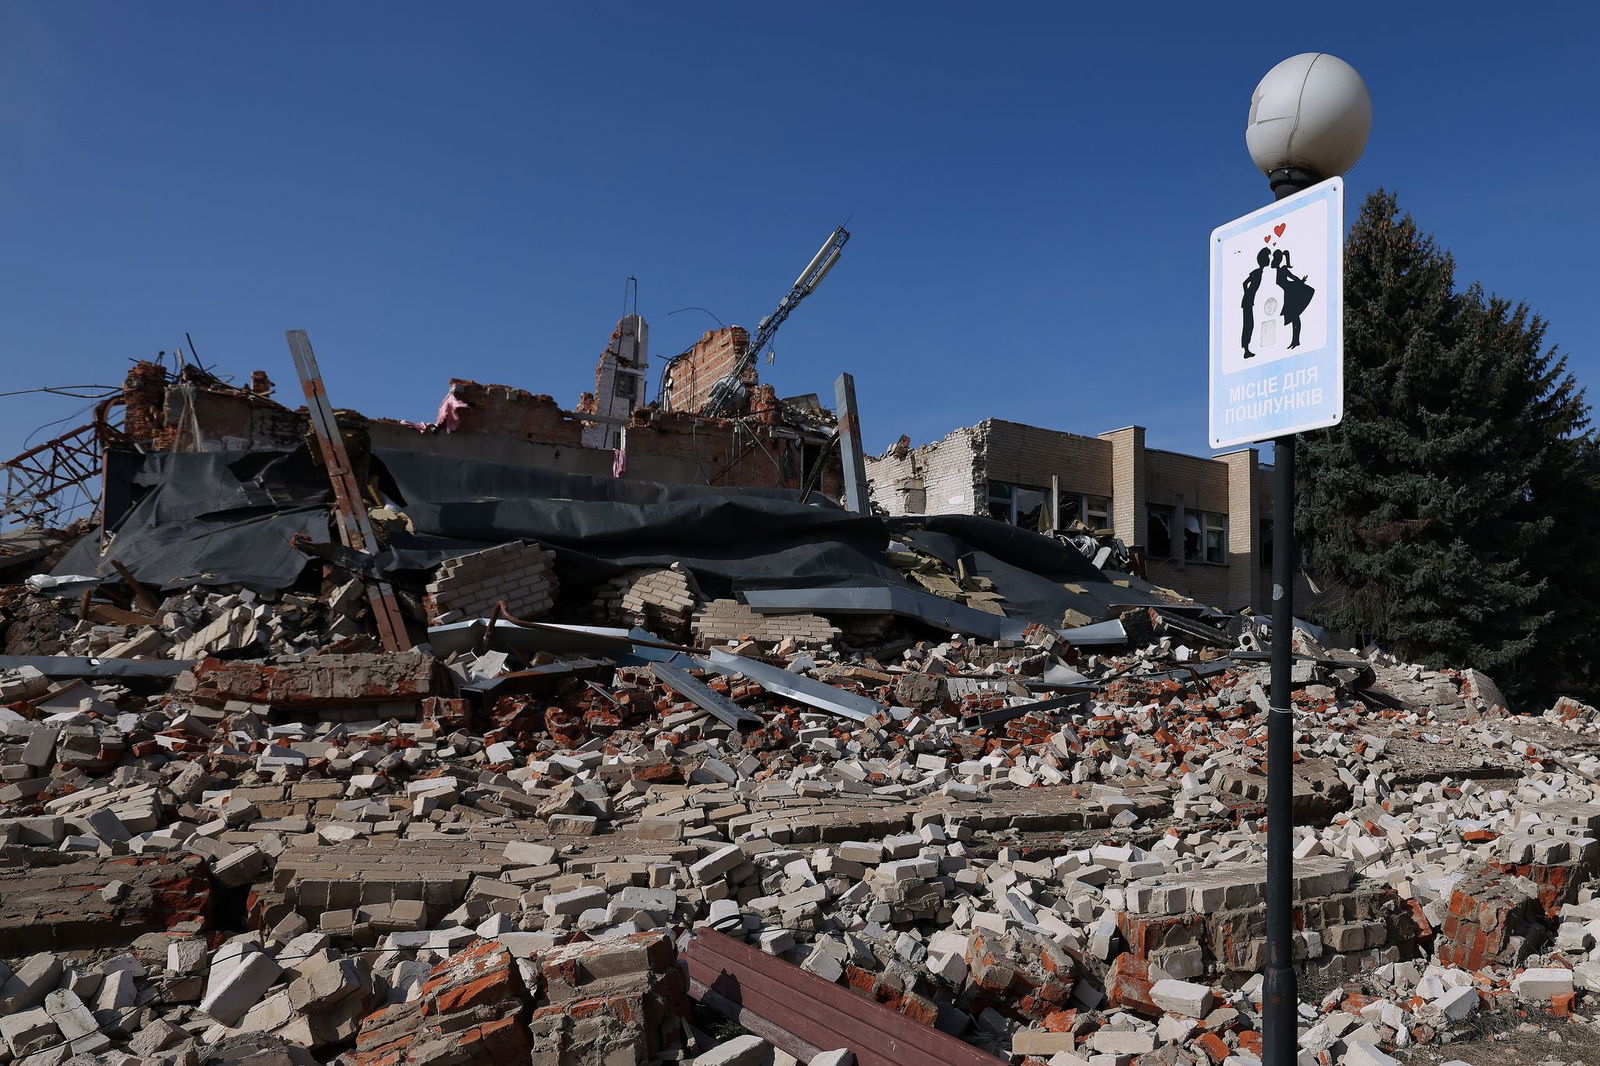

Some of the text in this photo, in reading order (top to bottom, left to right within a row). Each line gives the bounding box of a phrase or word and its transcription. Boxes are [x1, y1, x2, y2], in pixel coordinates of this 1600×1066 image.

[1229, 366, 1318, 403] МІСЦЕ ДЛЯ
[1225, 387, 1324, 425] ПОЦІЛУНКІВ
